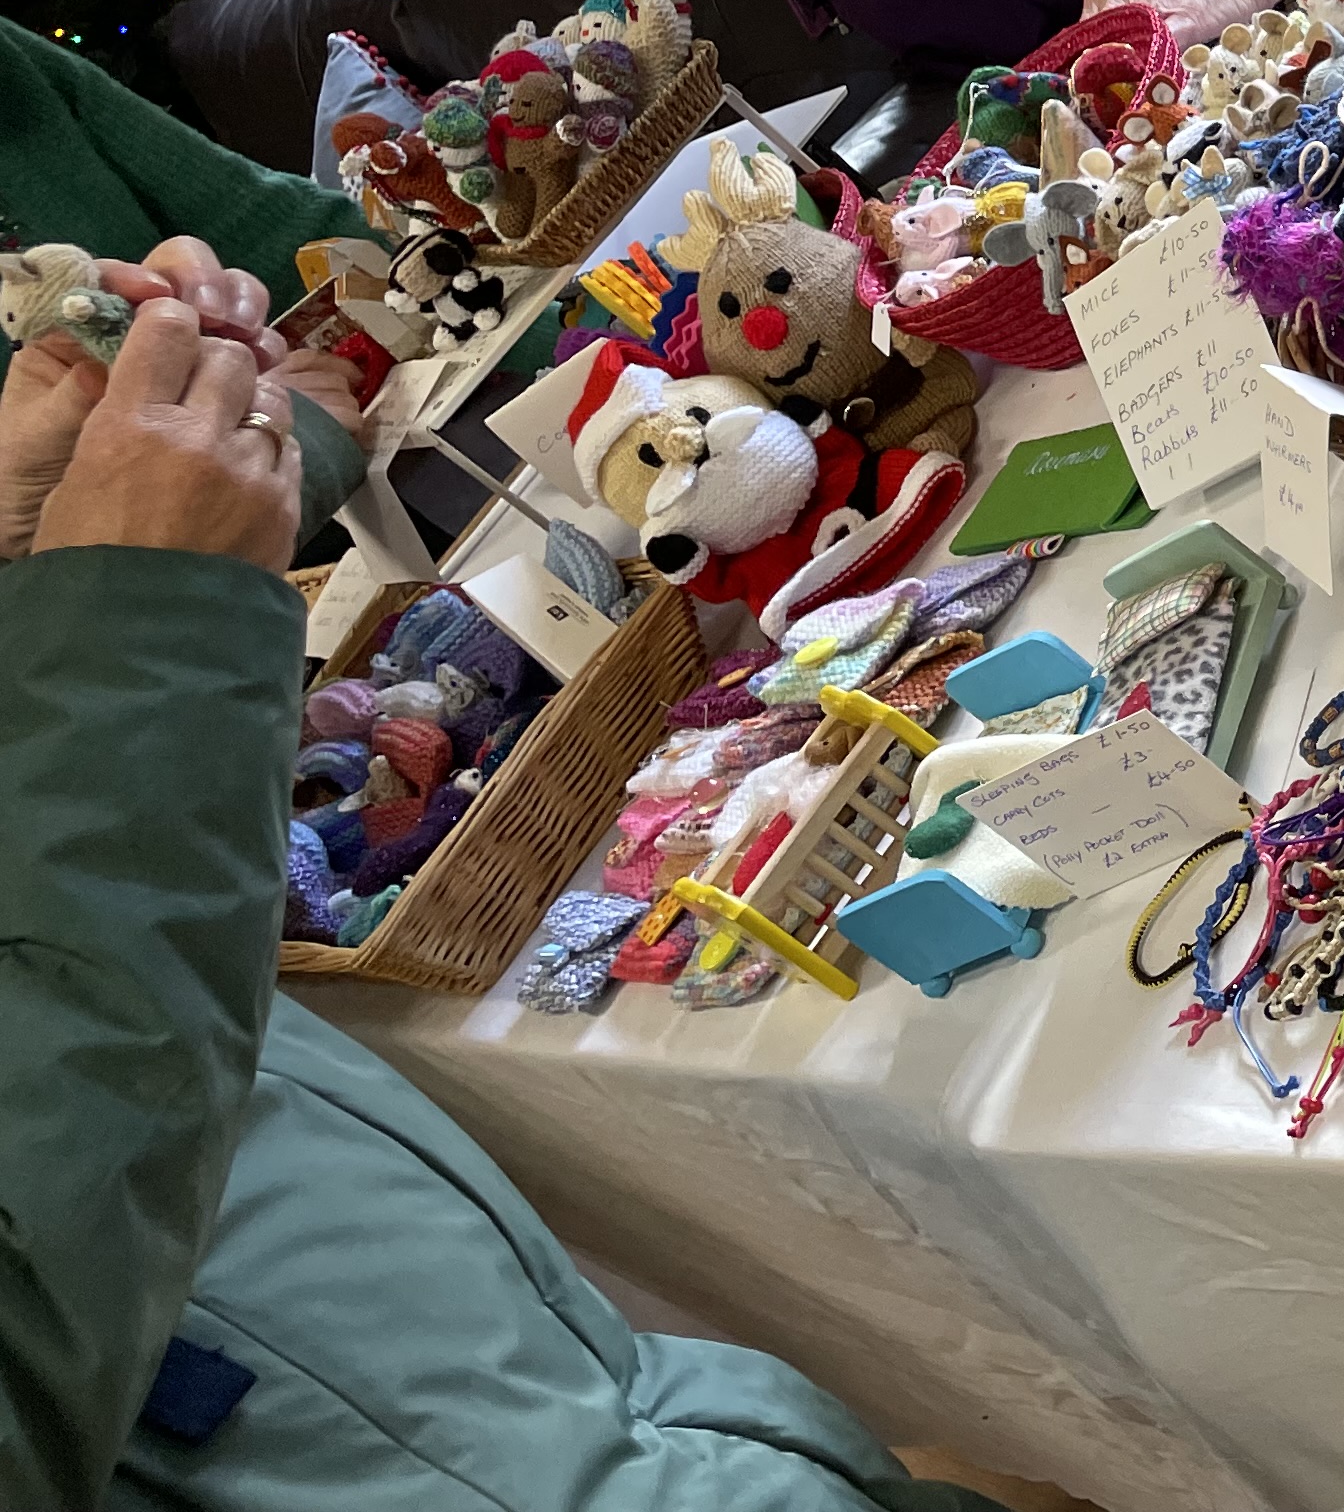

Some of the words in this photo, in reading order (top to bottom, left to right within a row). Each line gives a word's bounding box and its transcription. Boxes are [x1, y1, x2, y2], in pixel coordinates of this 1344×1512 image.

[1080, 278, 1120, 319] MICE
[1090, 310, 1140, 353] FOXES
[1118, 366, 1182, 423] BADGERS
[1131, 406, 1180, 444] Bears
[1265, 404, 1294, 437] HAND
[1140, 425, 1199, 470] Rabbits
[1265, 437, 1312, 474] WARMERS
[971, 773, 1039, 807] SLEEPING
[1040, 751, 1079, 772] BAGS
[993, 801, 1033, 826] CARRY
[1033, 789, 1066, 807] COTS
[1019, 826, 1058, 845] BEDS
[1131, 832, 1169, 853] EXTRA
